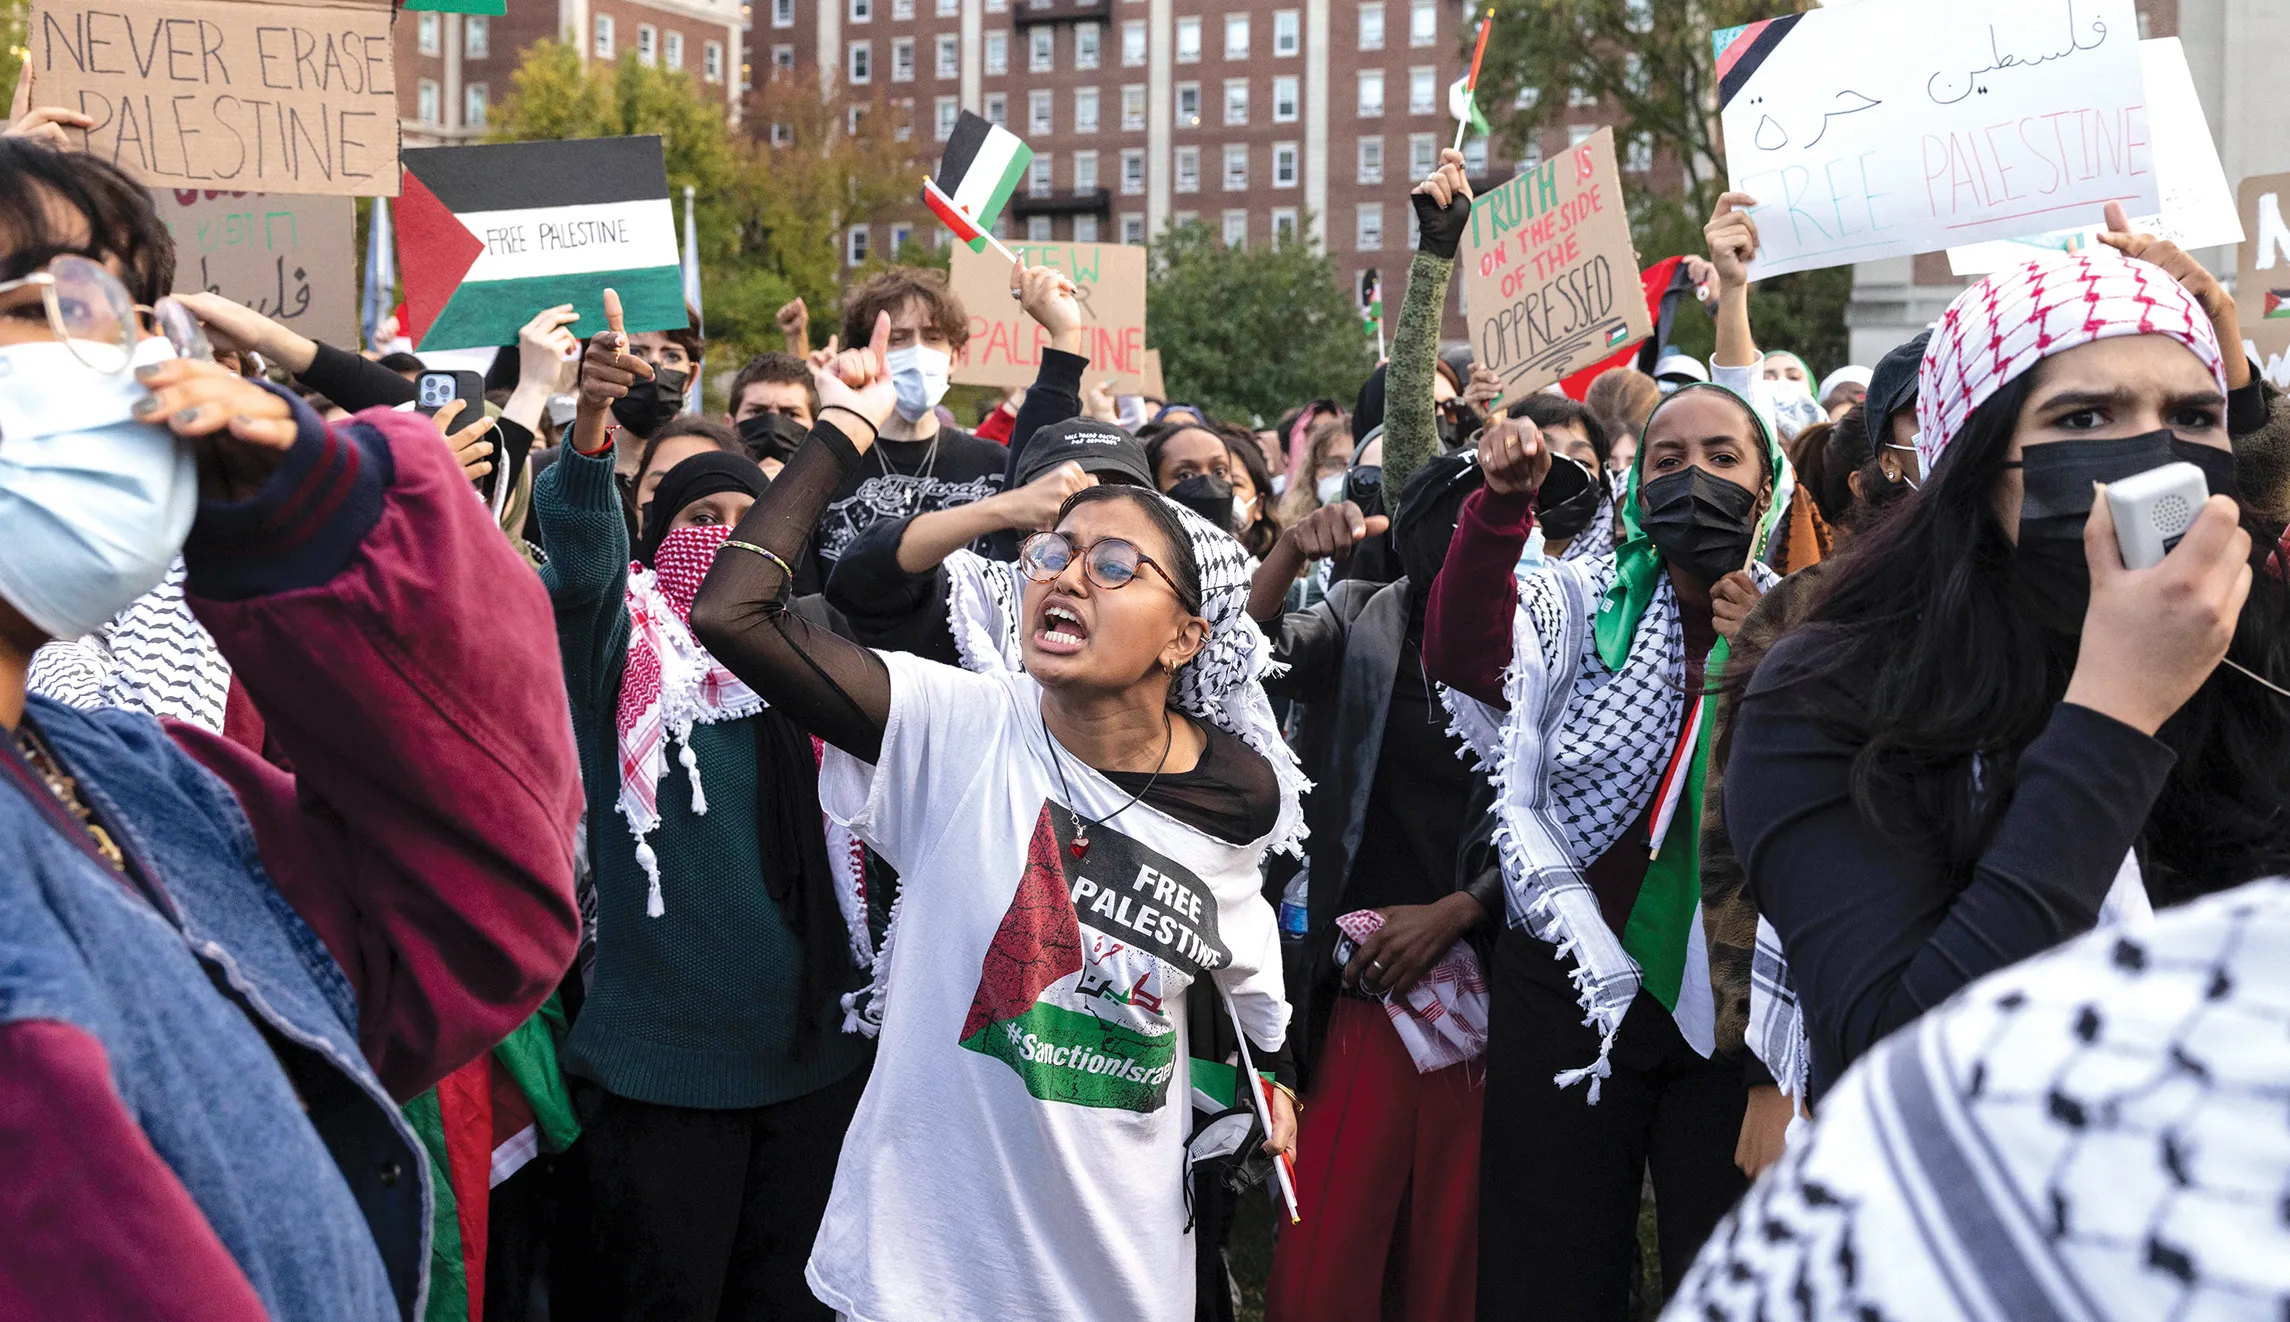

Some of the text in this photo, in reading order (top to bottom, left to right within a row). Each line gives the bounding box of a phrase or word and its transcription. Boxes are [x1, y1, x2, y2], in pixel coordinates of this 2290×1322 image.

[43, 11, 394, 95] NEVER ERASE
[1750, 0, 2107, 150] فلسطين حرة
[79, 90, 377, 181] PALESTINE
[1471, 145, 1594, 248] TRUTH IS
[1740, 105, 2148, 261] FREE PALESTINE
[486, 218, 629, 256] FREE PALESTINE
[1479, 184, 1603, 277] ON THE SIDE
[1500, 231, 1580, 299] OF THE
[961, 315, 1142, 375] PALEINE
[1483, 254, 1613, 370] OPPRESSED
[1071, 875, 1222, 971] PALESTINE
[1132, 864, 1202, 925] FREE
